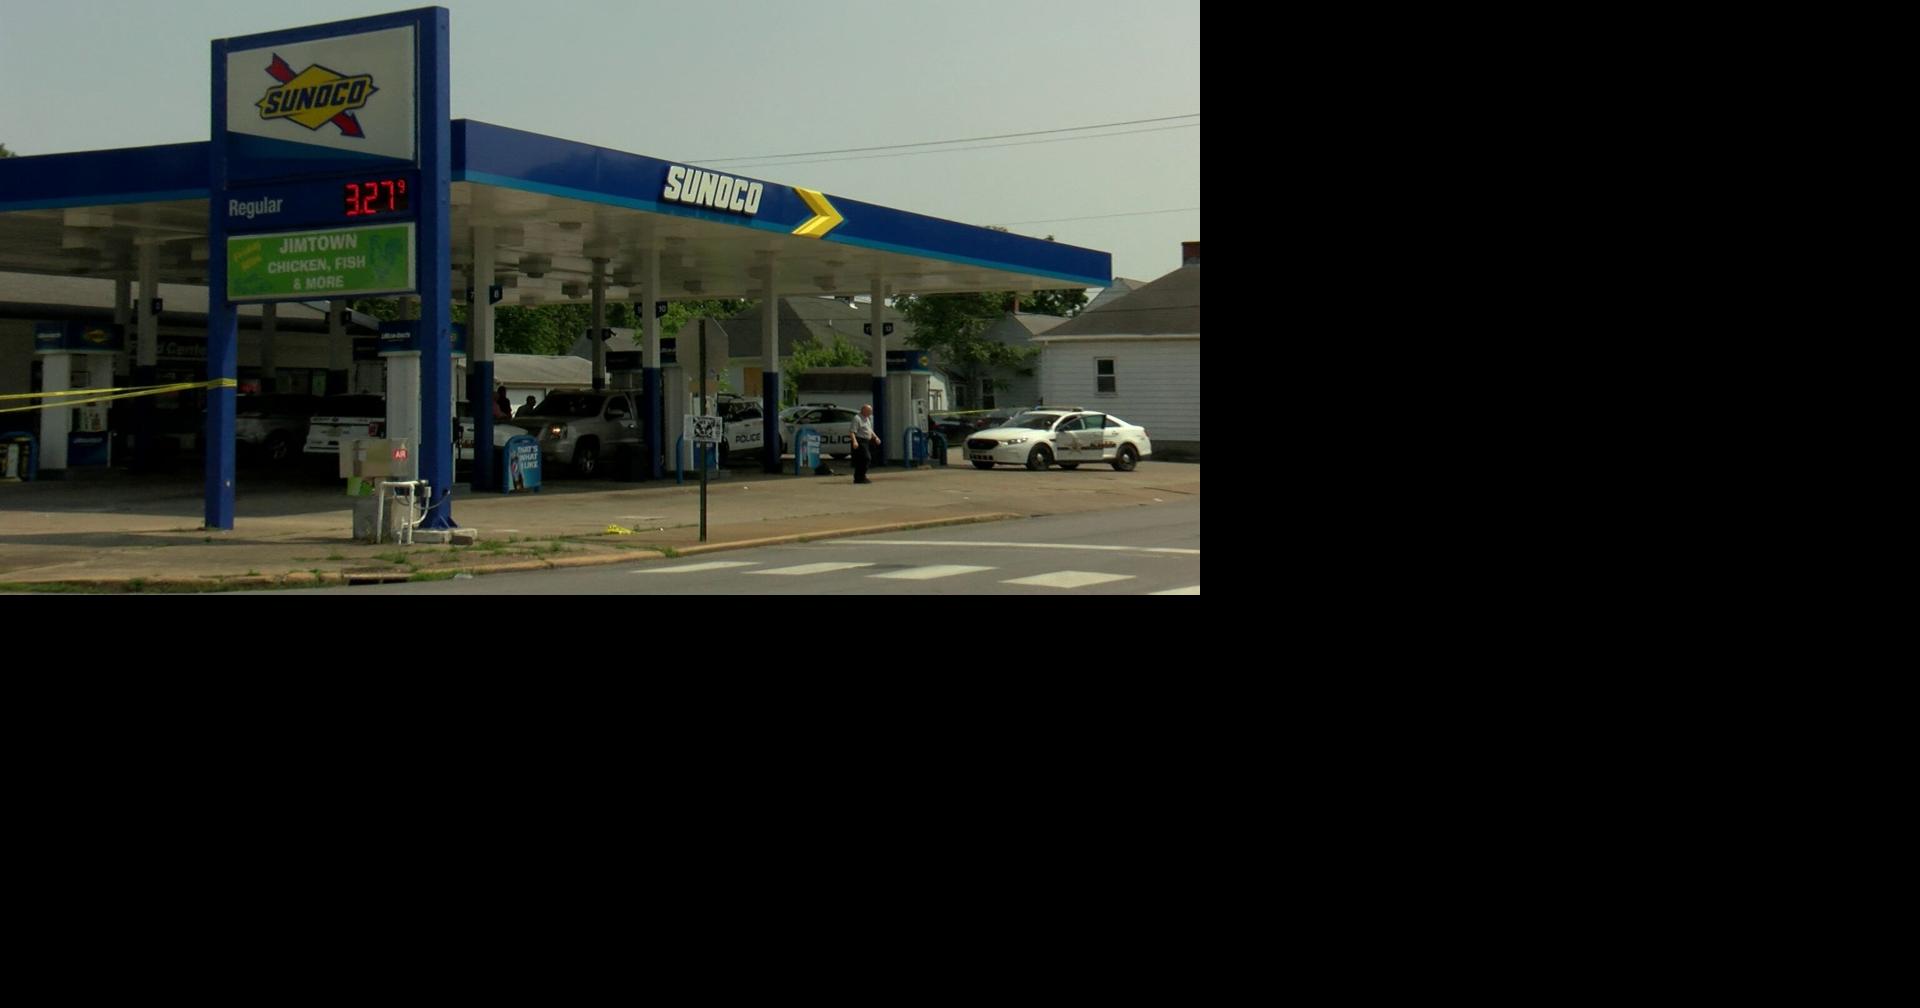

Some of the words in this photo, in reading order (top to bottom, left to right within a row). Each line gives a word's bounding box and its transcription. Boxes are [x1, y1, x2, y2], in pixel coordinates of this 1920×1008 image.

[265, 80, 366, 114] SUNOCO
[664, 165, 763, 214] SUNOCO
[229, 197, 283, 218] Regular
[279, 233, 357, 254] JIMTOWN
[268, 259, 331, 274] CHICKEN,
[335, 255, 366, 270] FISH
[293, 277, 301, 290] &
[306, 275, 344, 289] MORE
[735, 433, 761, 444] POLICE
